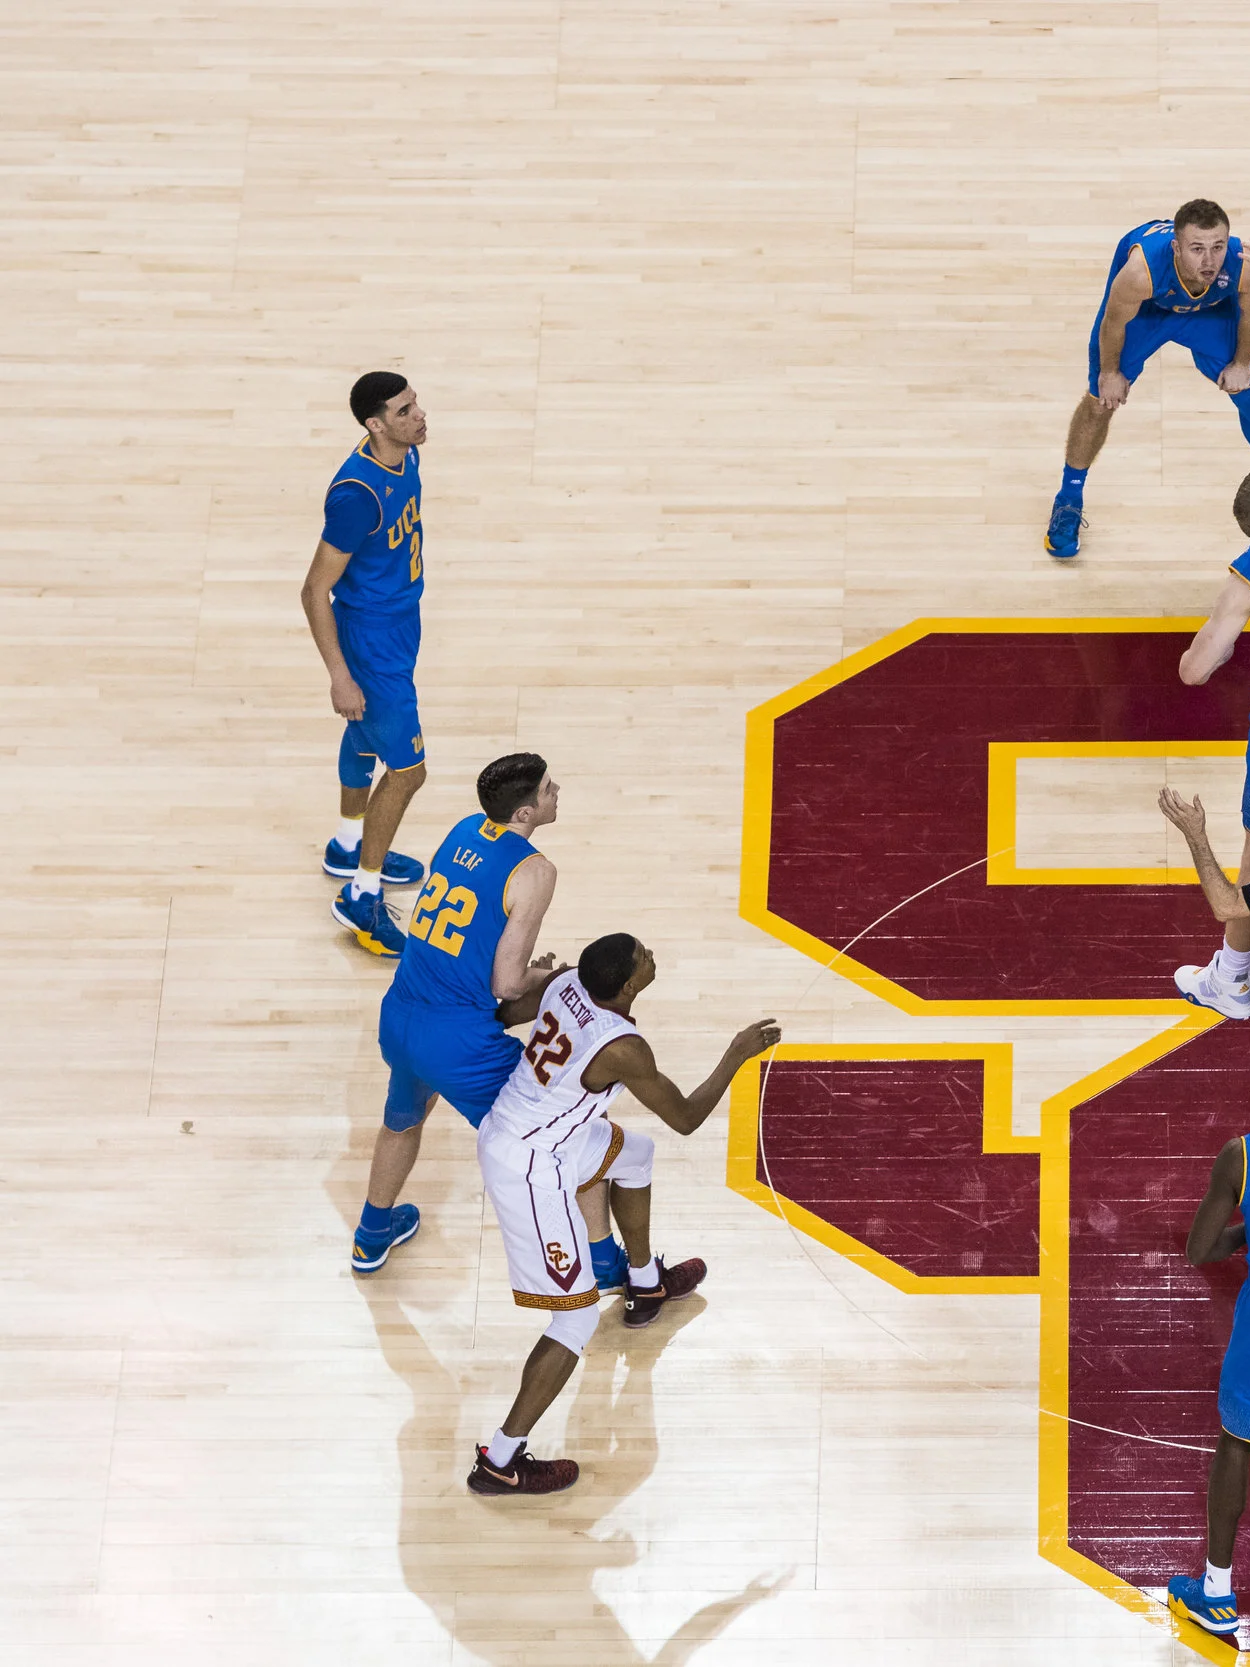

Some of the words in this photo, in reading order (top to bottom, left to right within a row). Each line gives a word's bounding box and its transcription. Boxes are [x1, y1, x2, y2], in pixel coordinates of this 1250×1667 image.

[410, 531, 422, 582] 2
[452, 846, 483, 872] LEAF
[408, 872, 478, 957] 22
[559, 983, 594, 1029] MELTON
[525, 1010, 572, 1087] 22
[546, 1241, 571, 1272] SC
